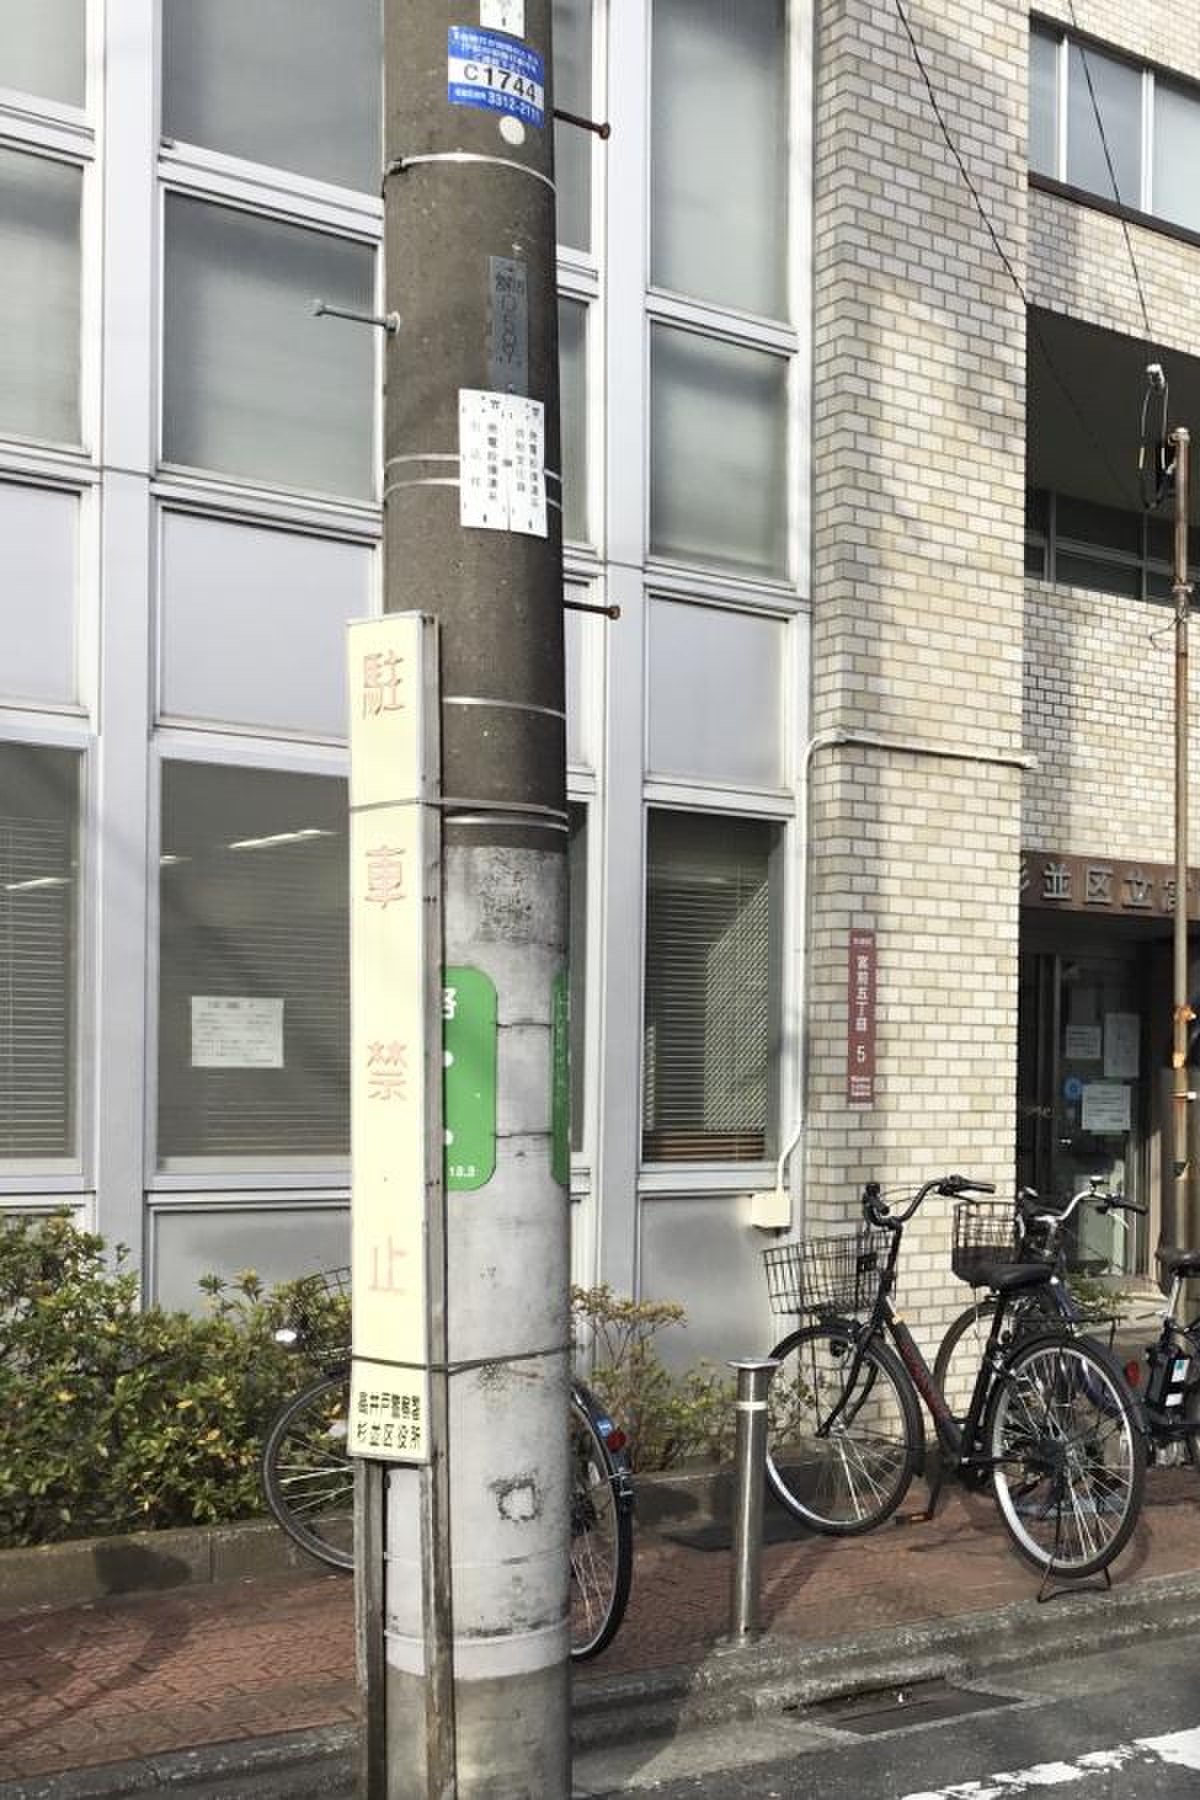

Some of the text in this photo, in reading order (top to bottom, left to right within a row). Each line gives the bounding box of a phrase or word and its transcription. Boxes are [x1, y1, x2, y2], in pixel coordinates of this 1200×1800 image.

[463, 63, 537, 103] C1744
[362, 649, 408, 1295] 駐車禁止
